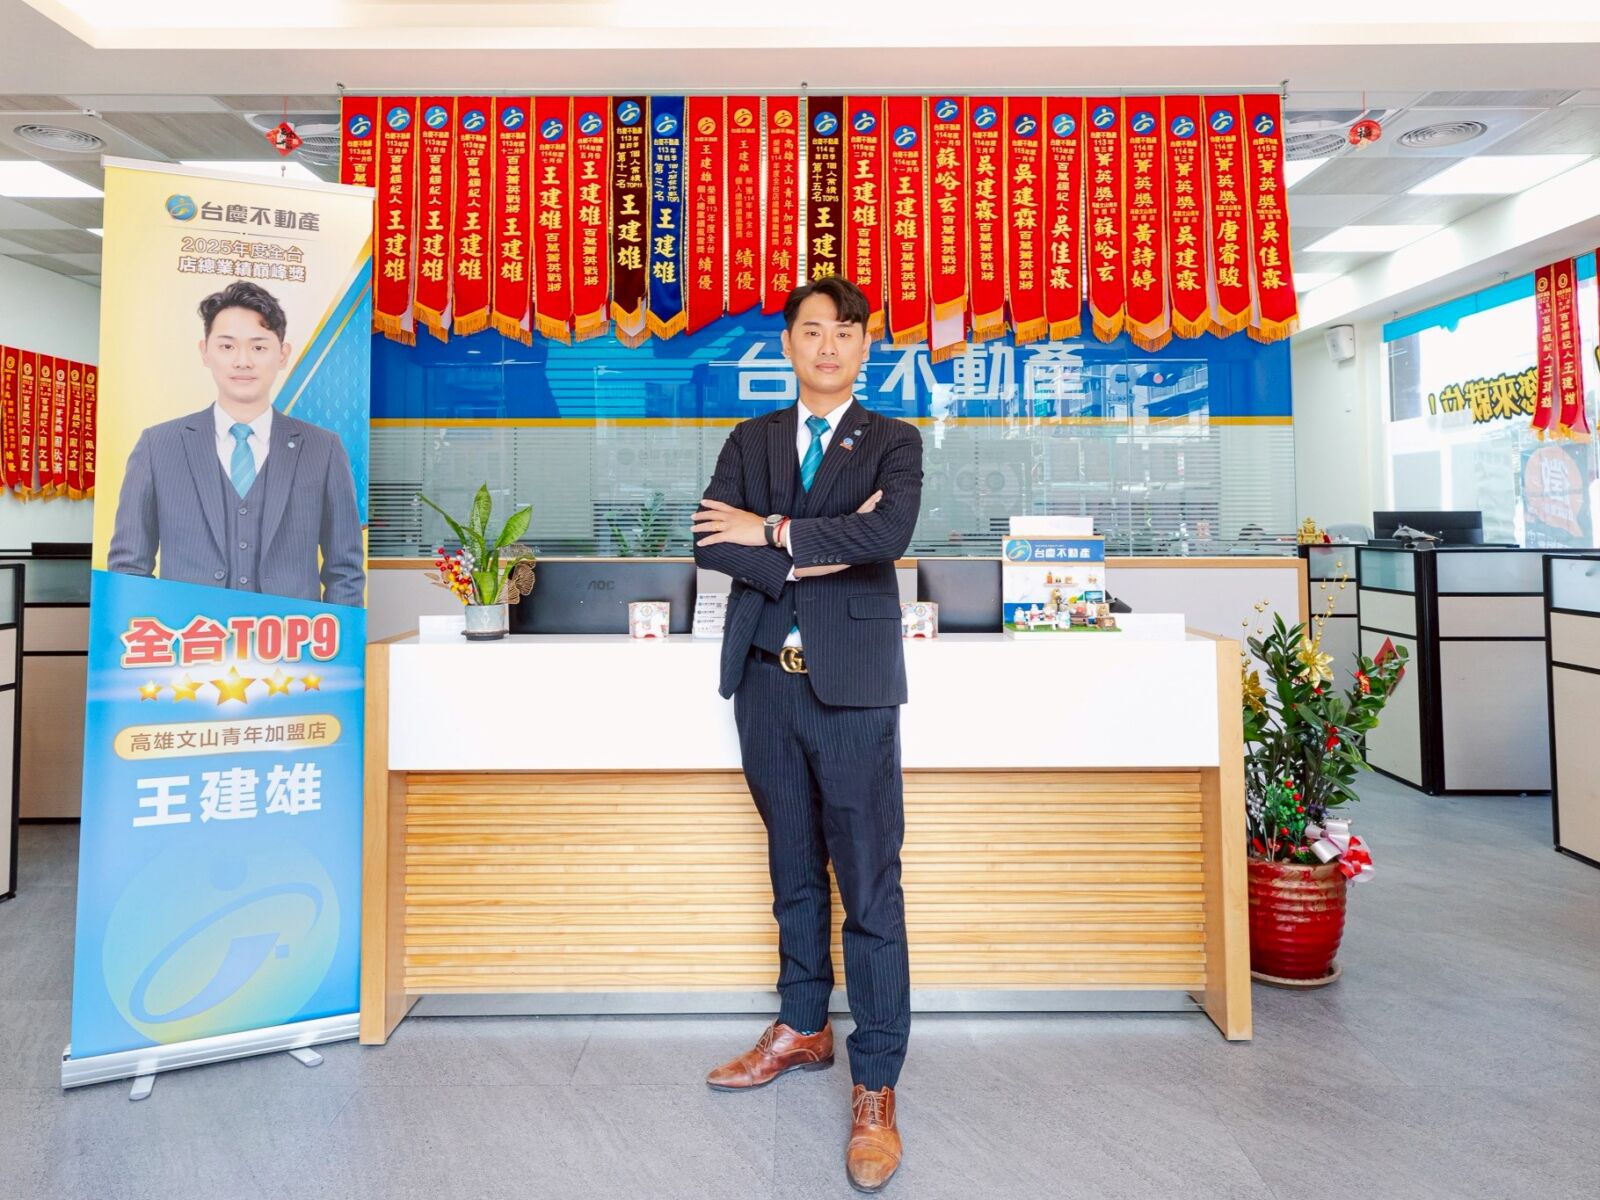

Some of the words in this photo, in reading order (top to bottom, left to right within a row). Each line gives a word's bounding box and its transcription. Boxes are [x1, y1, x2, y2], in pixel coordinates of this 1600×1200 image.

[384, 132, 411, 140] 台慶不動產
[461, 134, 487, 142] 台慶不動產
[500, 132, 526, 140] 台慶不動產
[502, 140, 524, 148] 113年度
[654, 138, 680, 146] 台慶不動產
[738, 140, 750, 172] 王建雄
[851, 136, 877, 144] 台慶不動產
[852, 144, 876, 152] 115年度
[1170, 140, 1197, 148] 台慶不動產
[352, 163, 368, 186] 百萬
[389, 155, 403, 204] 百萬經紀人
[428, 154, 442, 204] 百萬經紀人
[466, 157, 481, 208] 百萬經紀人
[616, 152, 628, 188] 第十一名
[654, 162, 664, 201] 第三名
[700, 144, 712, 183] 王建雄
[812, 162, 823, 202] 第十五名
[935, 147, 961, 213] 蘇峪玄
[975, 155, 998, 220] 吳建霖
[1056, 162, 1070, 212] 百萬經紀人
[1094, 153, 1114, 201] 菁英獎
[1134, 159, 1154, 207] 菁英獎
[1176, 162, 1196, 209] 菁英獎
[1216, 158, 1238, 204] 菁英獎
[1258, 160, 1278, 208] 菁英獎
[538, 166, 563, 230] 王建雄
[578, 161, 602, 226] 王建雄
[783, 138, 794, 246] 高雄文山青年加盟店
[852, 159, 878, 227] 王建雄
[894, 176, 918, 240] 王建雄
[1012, 164, 1038, 229] 吳建霖
[201, 202, 320, 232] 台慶不動產
[617, 194, 643, 270] 王建雄
[181, 236, 305, 263] 2025年度全台
[384, 210, 407, 282] 王建雄
[422, 210, 446, 282] 王建雄
[458, 211, 483, 281] 王建雄
[500, 218, 524, 282] 王建雄
[653, 208, 676, 284] 王建雄
[812, 207, 837, 281] 王建雄
[1050, 214, 1072, 290] 吳佳霖
[1094, 216, 1119, 282] 蘇峪玄
[1131, 223, 1156, 291] 黃詩婷
[1176, 226, 1201, 291] 吳建霖
[1216, 220, 1243, 288] 唐睿駿
[1259, 222, 1288, 290] 吳佳霖
[177, 256, 306, 282] 店總業績巔峰獎
[698, 256, 713, 290] 績優
[735, 248, 756, 290] 績優
[772, 249, 792, 292] 績優
[1560, 312, 1574, 358] 百萬經紀人
[738, 342, 1086, 401] 台不動產
[1562, 362, 1576, 405] 王建雄
[1034, 548, 1091, 558] 台慶不動產
[587, 580, 615, 590] AOC
[121, 614, 340, 668] 全台TOP9
[130, 722, 327, 752] 高雄文山青年加盟店
[132, 762, 322, 828] 王建雄
